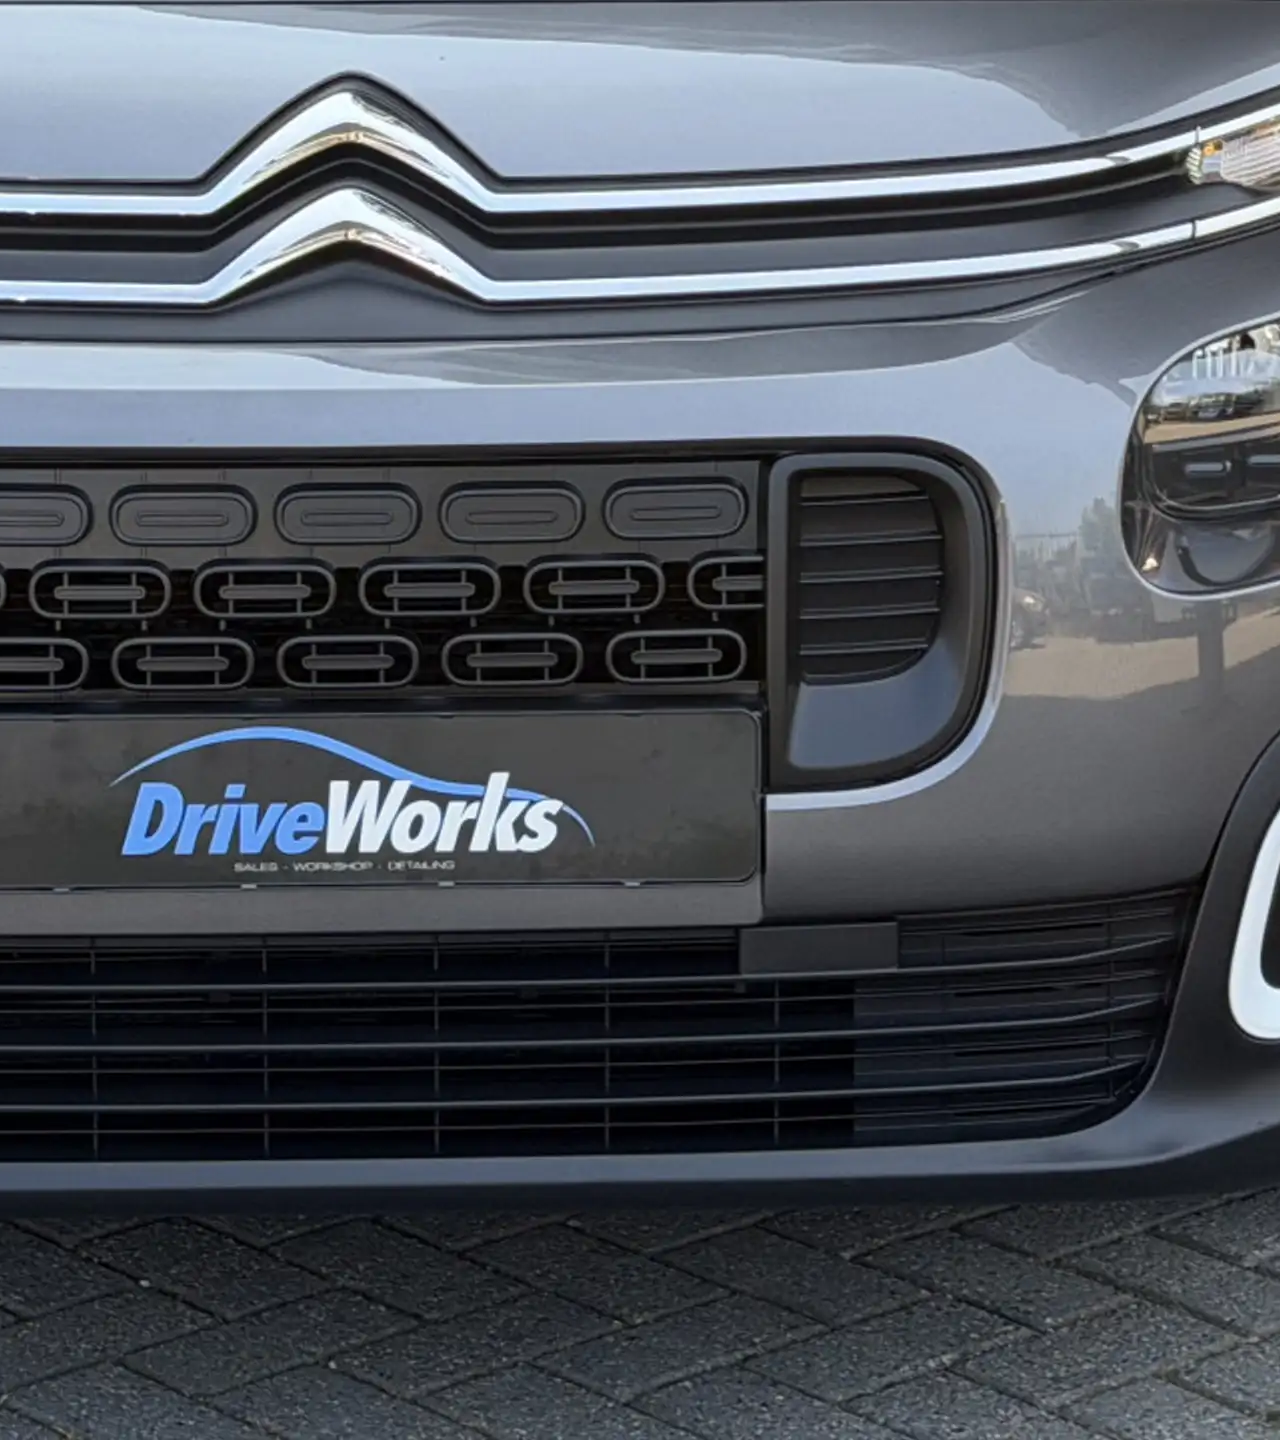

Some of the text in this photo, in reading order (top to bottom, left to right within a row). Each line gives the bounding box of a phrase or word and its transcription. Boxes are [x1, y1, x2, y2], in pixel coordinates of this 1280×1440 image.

[122, 772, 564, 856] DriveWorks
[233, 860, 456, 872] SALES WORKSHOP DETAILING
